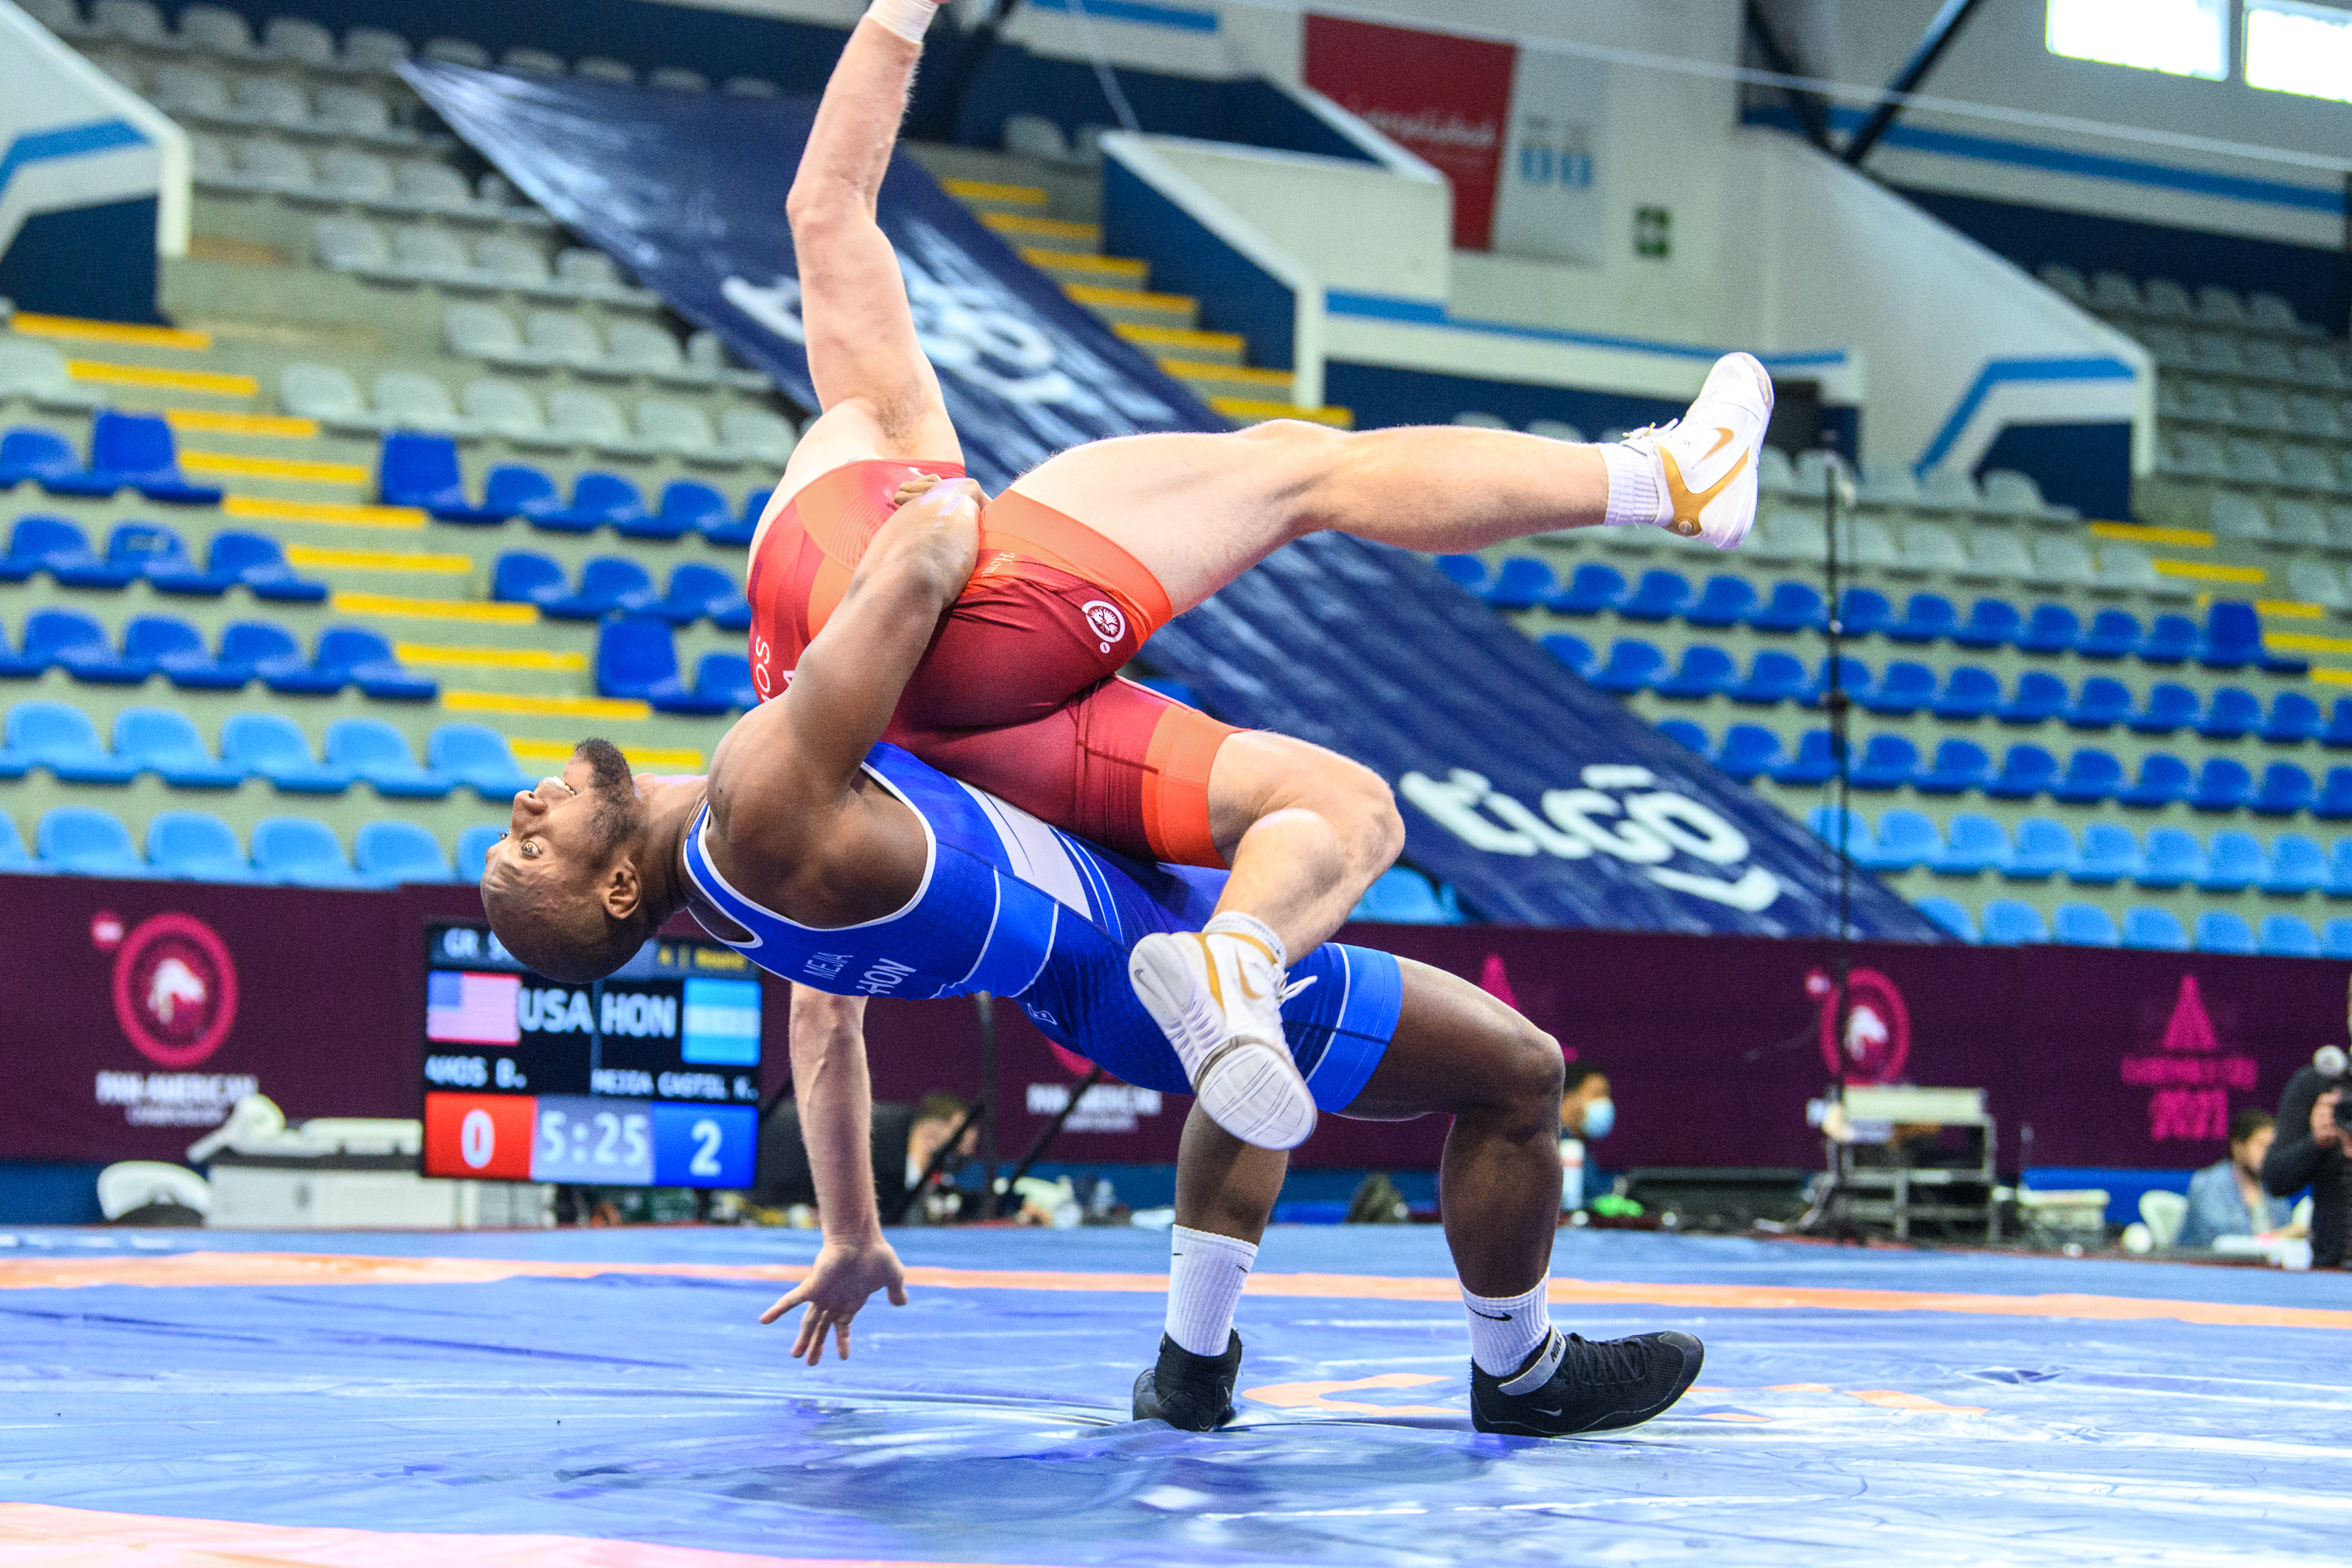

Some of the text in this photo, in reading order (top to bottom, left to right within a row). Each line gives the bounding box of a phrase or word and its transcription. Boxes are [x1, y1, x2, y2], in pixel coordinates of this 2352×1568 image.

[1399, 764, 1780, 912] tigo
[856, 957, 916, 994] HON
[518, 986, 593, 1033] USA
[601, 992, 677, 1037] HON
[461, 1109, 495, 1169] 0
[539, 1110, 649, 1166] 5:25
[689, 1120, 722, 1176] 2
